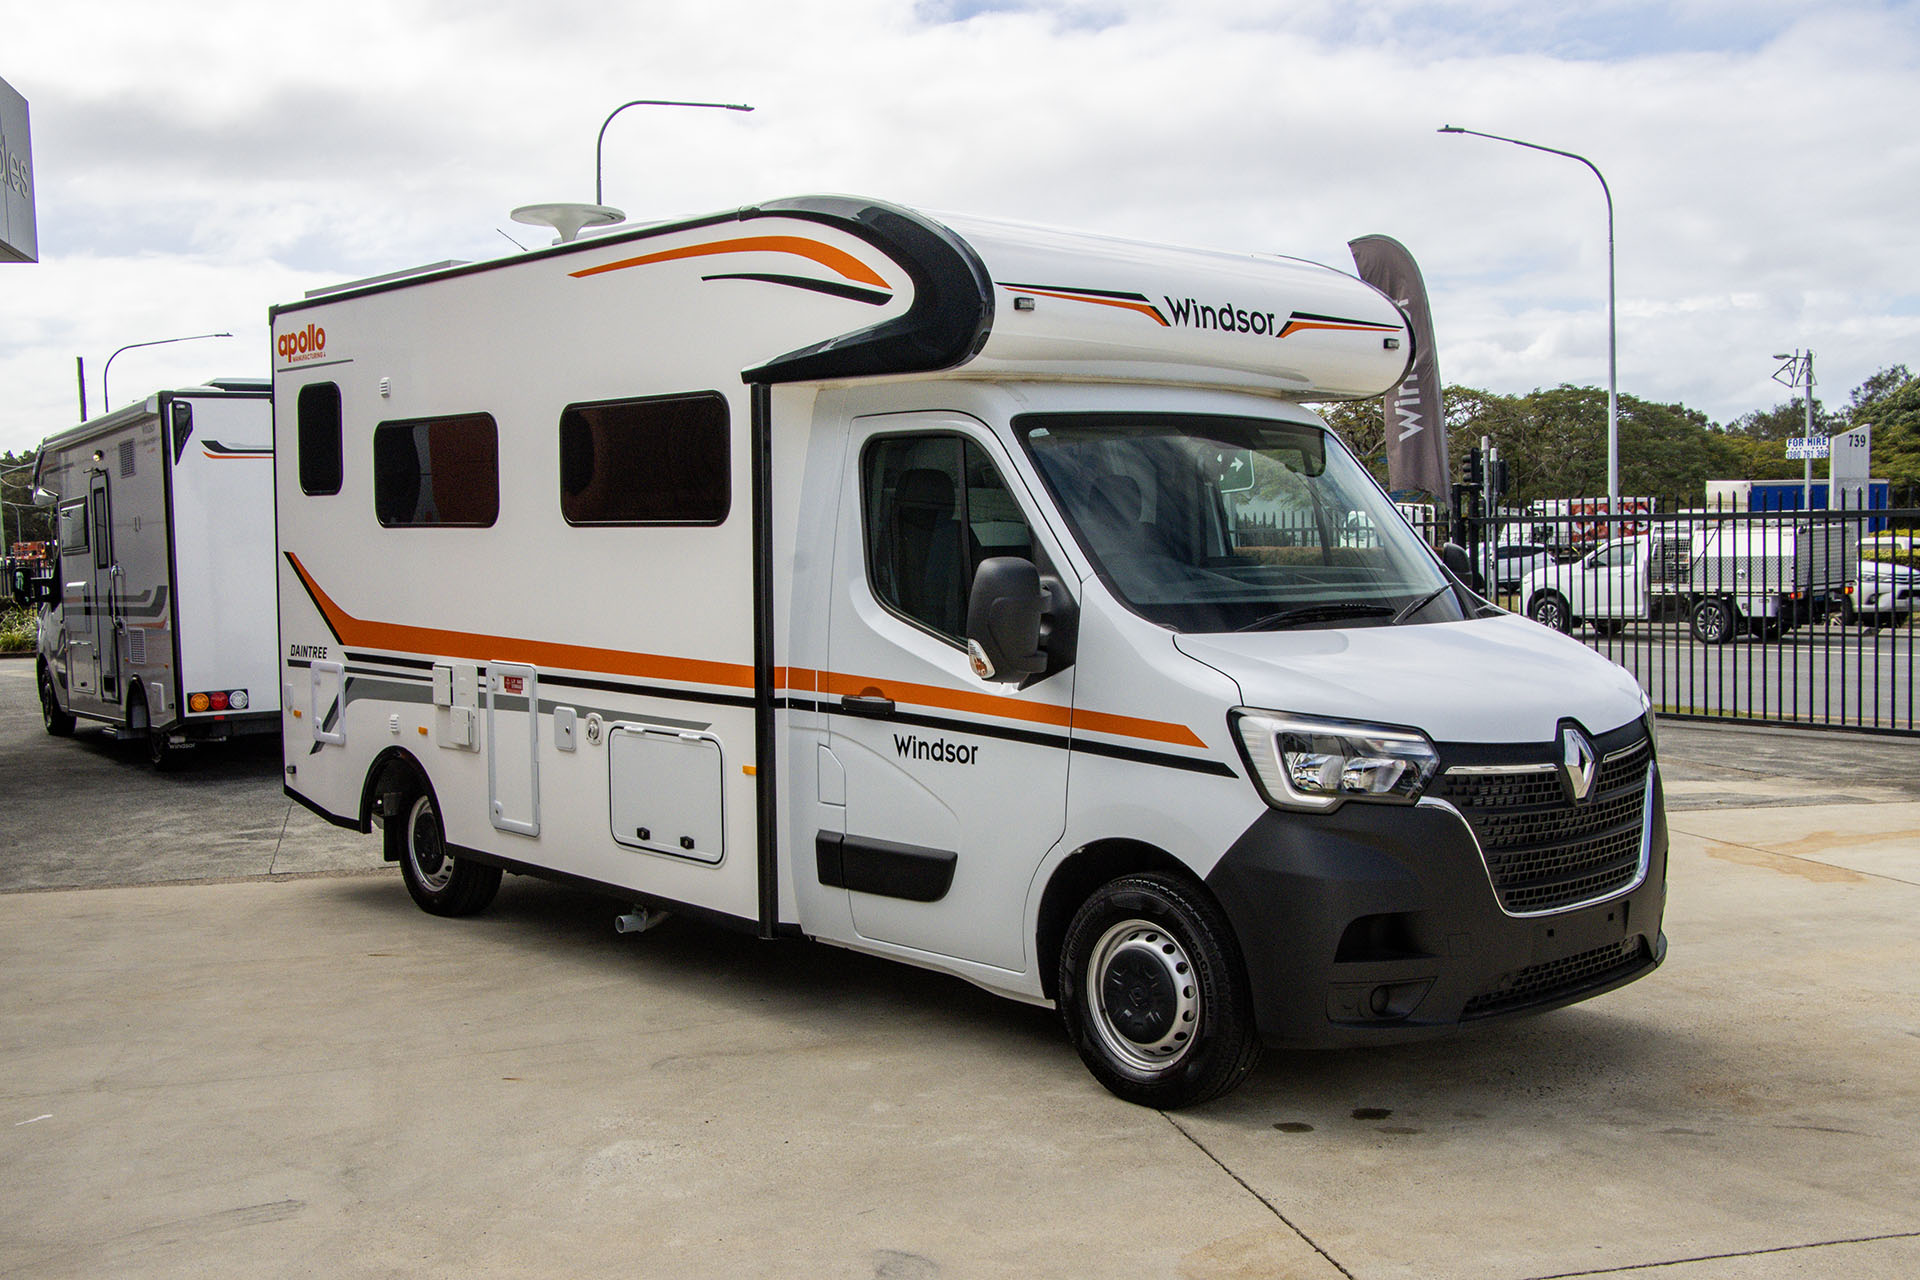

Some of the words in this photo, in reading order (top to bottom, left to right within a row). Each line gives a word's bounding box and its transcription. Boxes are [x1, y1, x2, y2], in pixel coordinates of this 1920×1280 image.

[0, 135, 28, 199] les
[1163, 295, 1275, 336] Windsor
[278, 323, 326, 363] apollo
[1788, 438, 1804, 447] FOR
[1807, 437, 1827, 446] HIRE
[1848, 434, 1866, 448] 739
[290, 644, 328, 659] DAINTREE
[893, 733, 979, 765] Windsor
